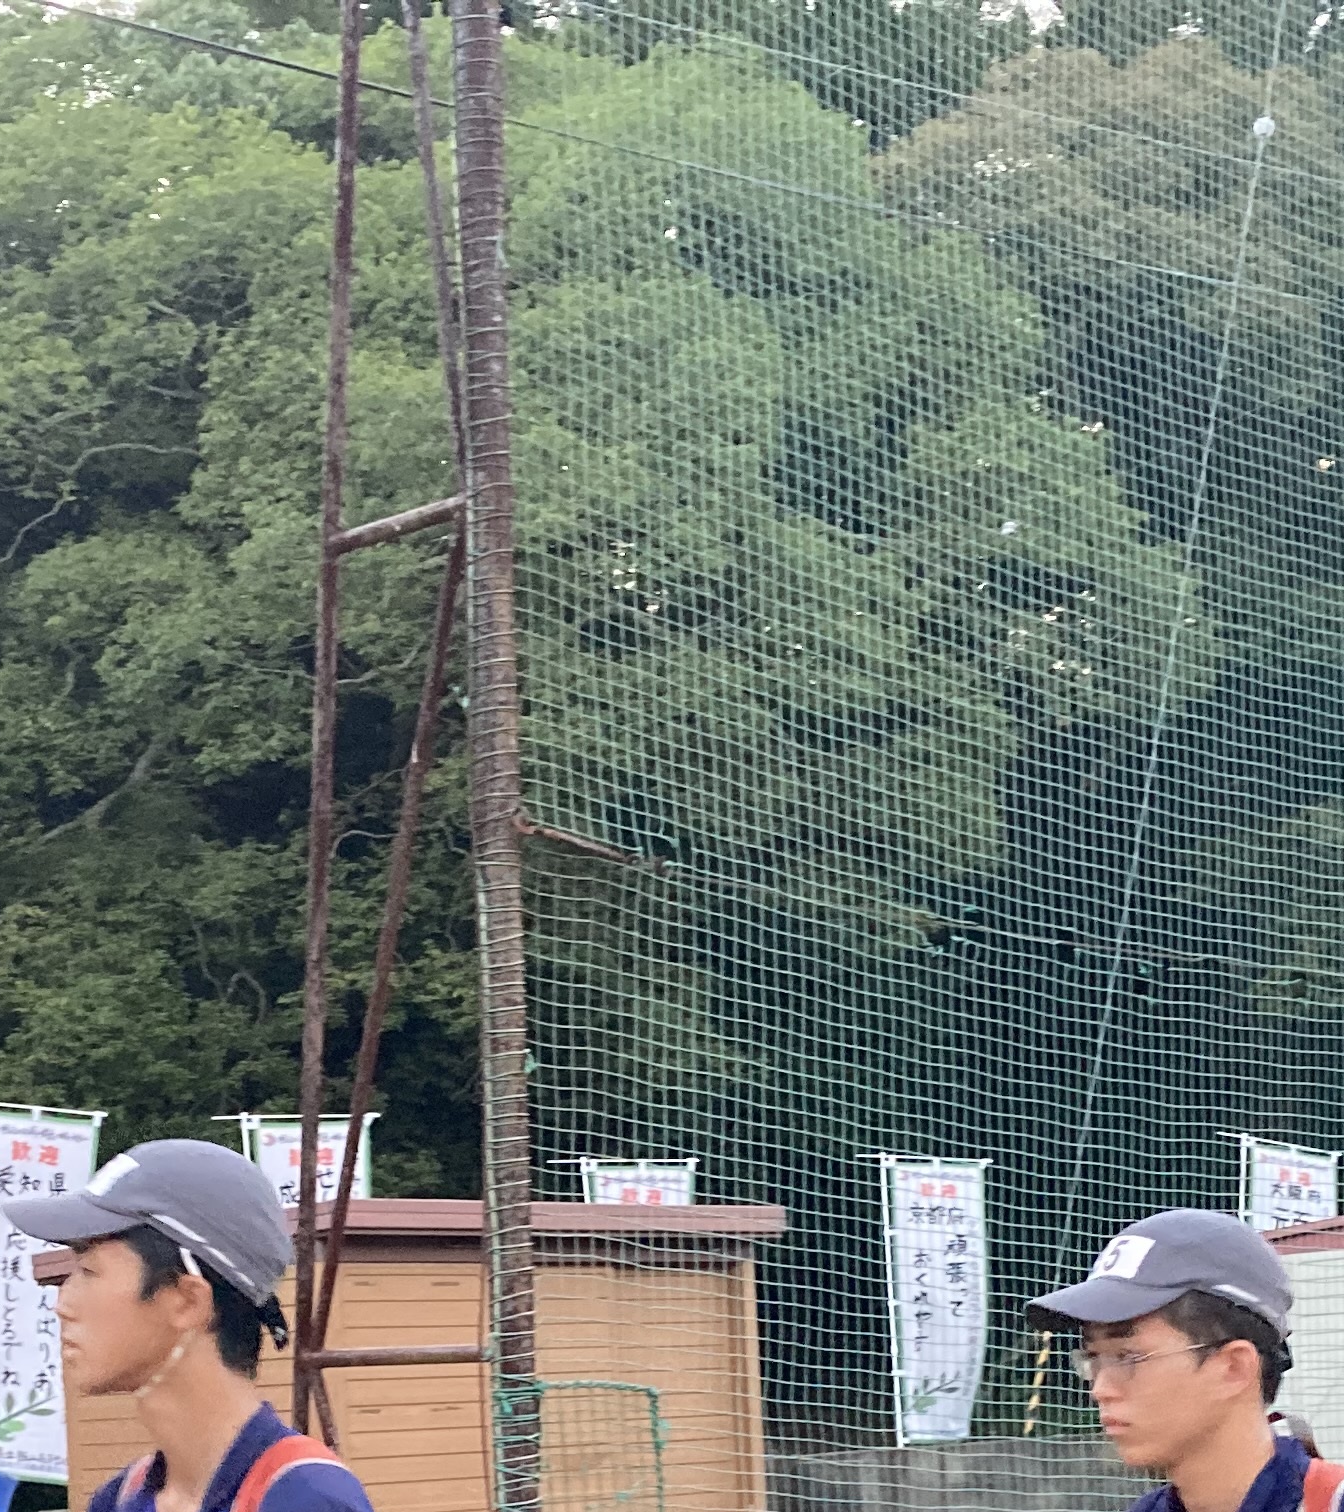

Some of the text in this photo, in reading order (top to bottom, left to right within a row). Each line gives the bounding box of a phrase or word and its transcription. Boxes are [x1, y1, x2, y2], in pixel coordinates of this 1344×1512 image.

[10, 1140, 60, 1167] 歓迎
[1271, 1183, 1321, 1204] 大阪府
[908, 1202, 965, 1225] 京都府
